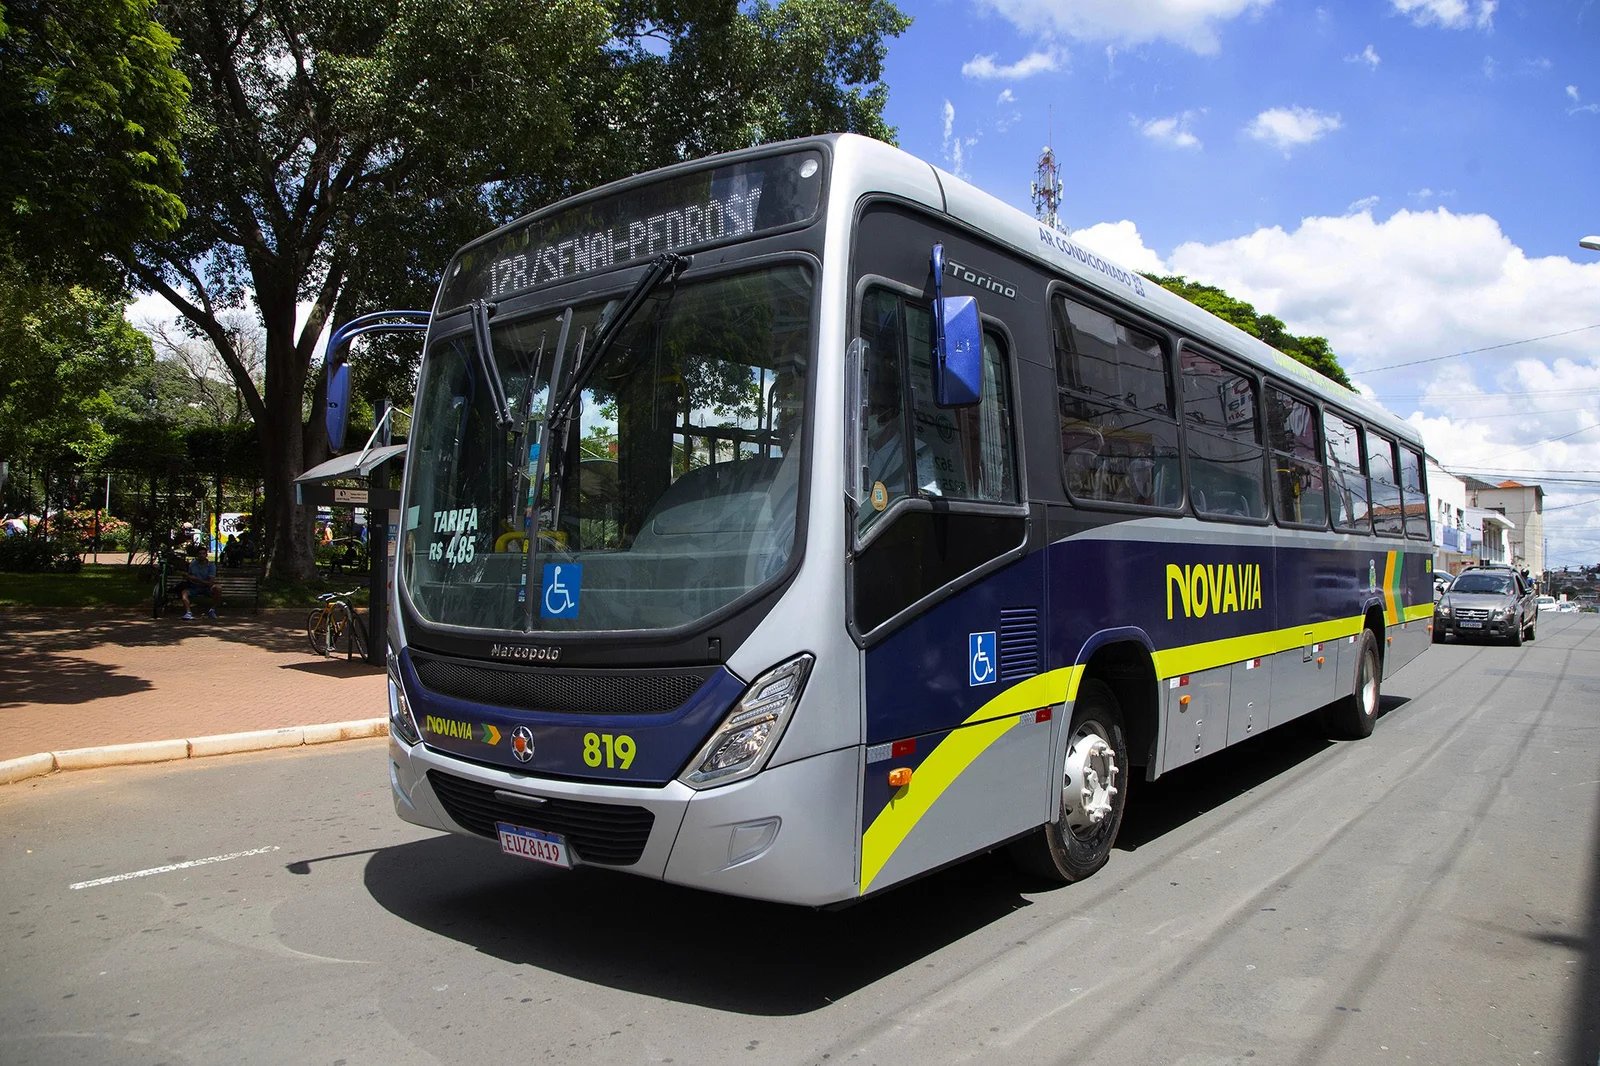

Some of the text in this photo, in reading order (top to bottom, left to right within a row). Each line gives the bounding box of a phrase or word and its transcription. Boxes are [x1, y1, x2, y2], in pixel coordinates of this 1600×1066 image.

[1039, 227, 1132, 286] AR CONDICIONADO
[949, 261, 1016, 298] Torino
[433, 507, 478, 533] TARIFA
[428, 536, 475, 569] R$ 4,85
[1166, 563, 1262, 620] NOVAVIA
[491, 643, 561, 661] Marcopolo
[426, 714, 473, 741] NOVAVIA
[582, 732, 637, 770] 819
[505, 834, 560, 862] EUZ8A19
